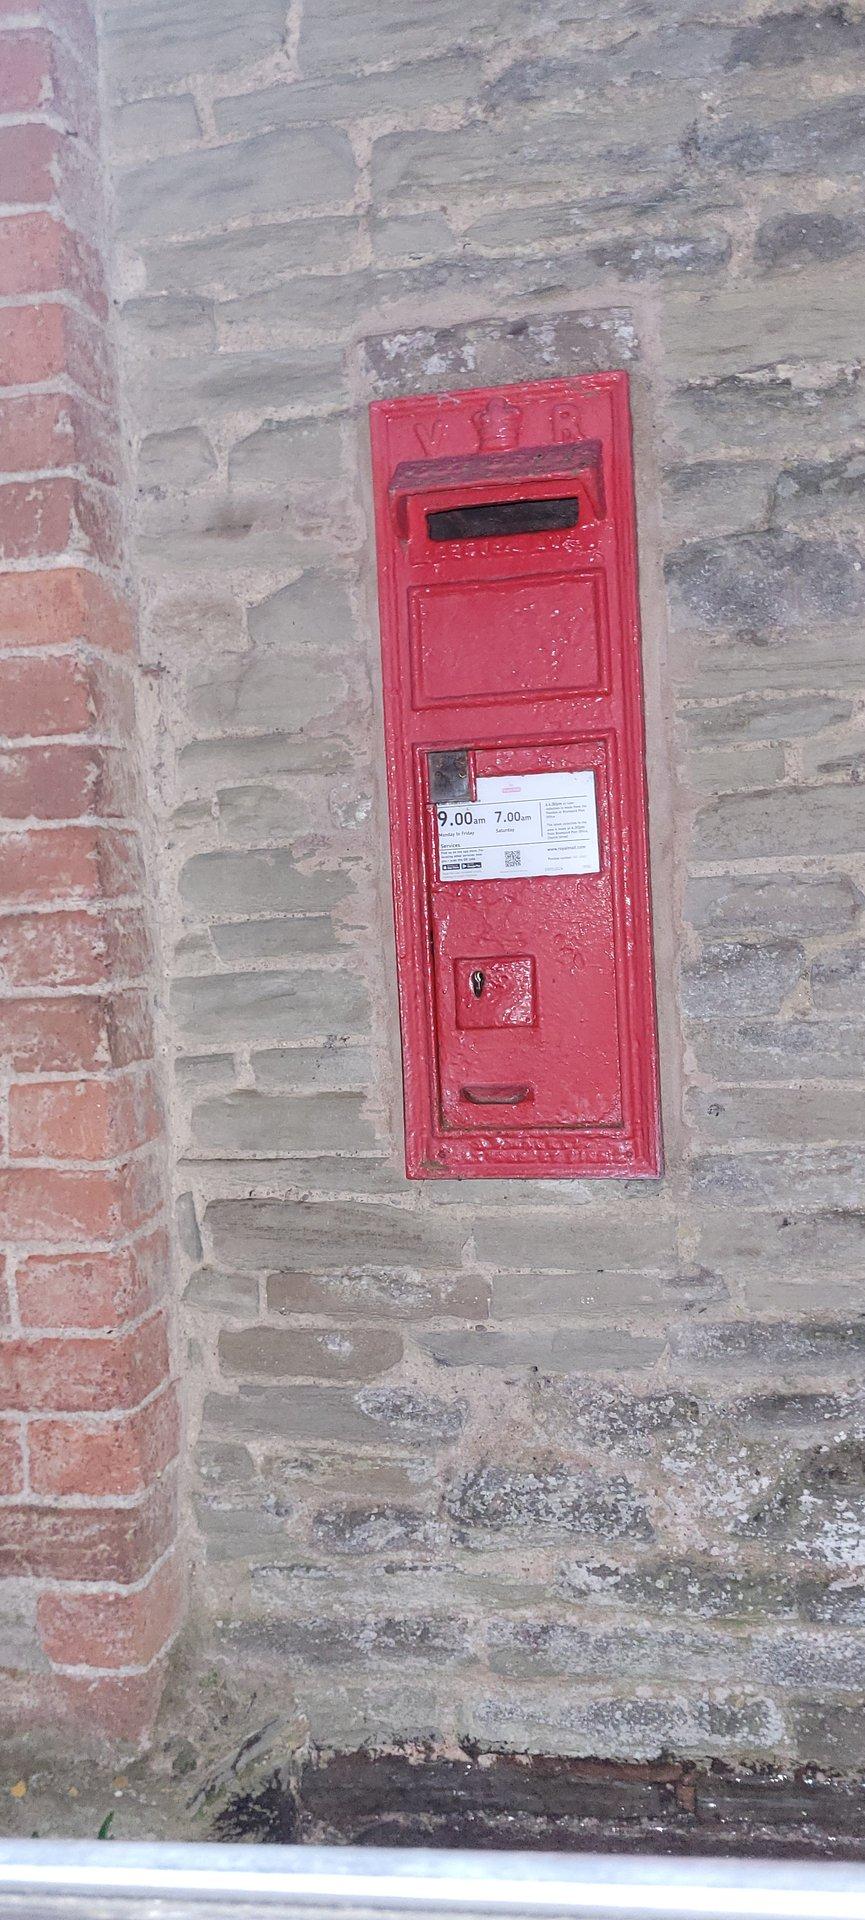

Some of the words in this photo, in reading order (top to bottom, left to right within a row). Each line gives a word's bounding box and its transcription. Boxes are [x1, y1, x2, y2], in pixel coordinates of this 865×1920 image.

[413, 418, 442, 457] V
[551, 403, 585, 444] R
[438, 810, 486, 827] 9.00am
[494, 811, 532, 823] 7.00am
